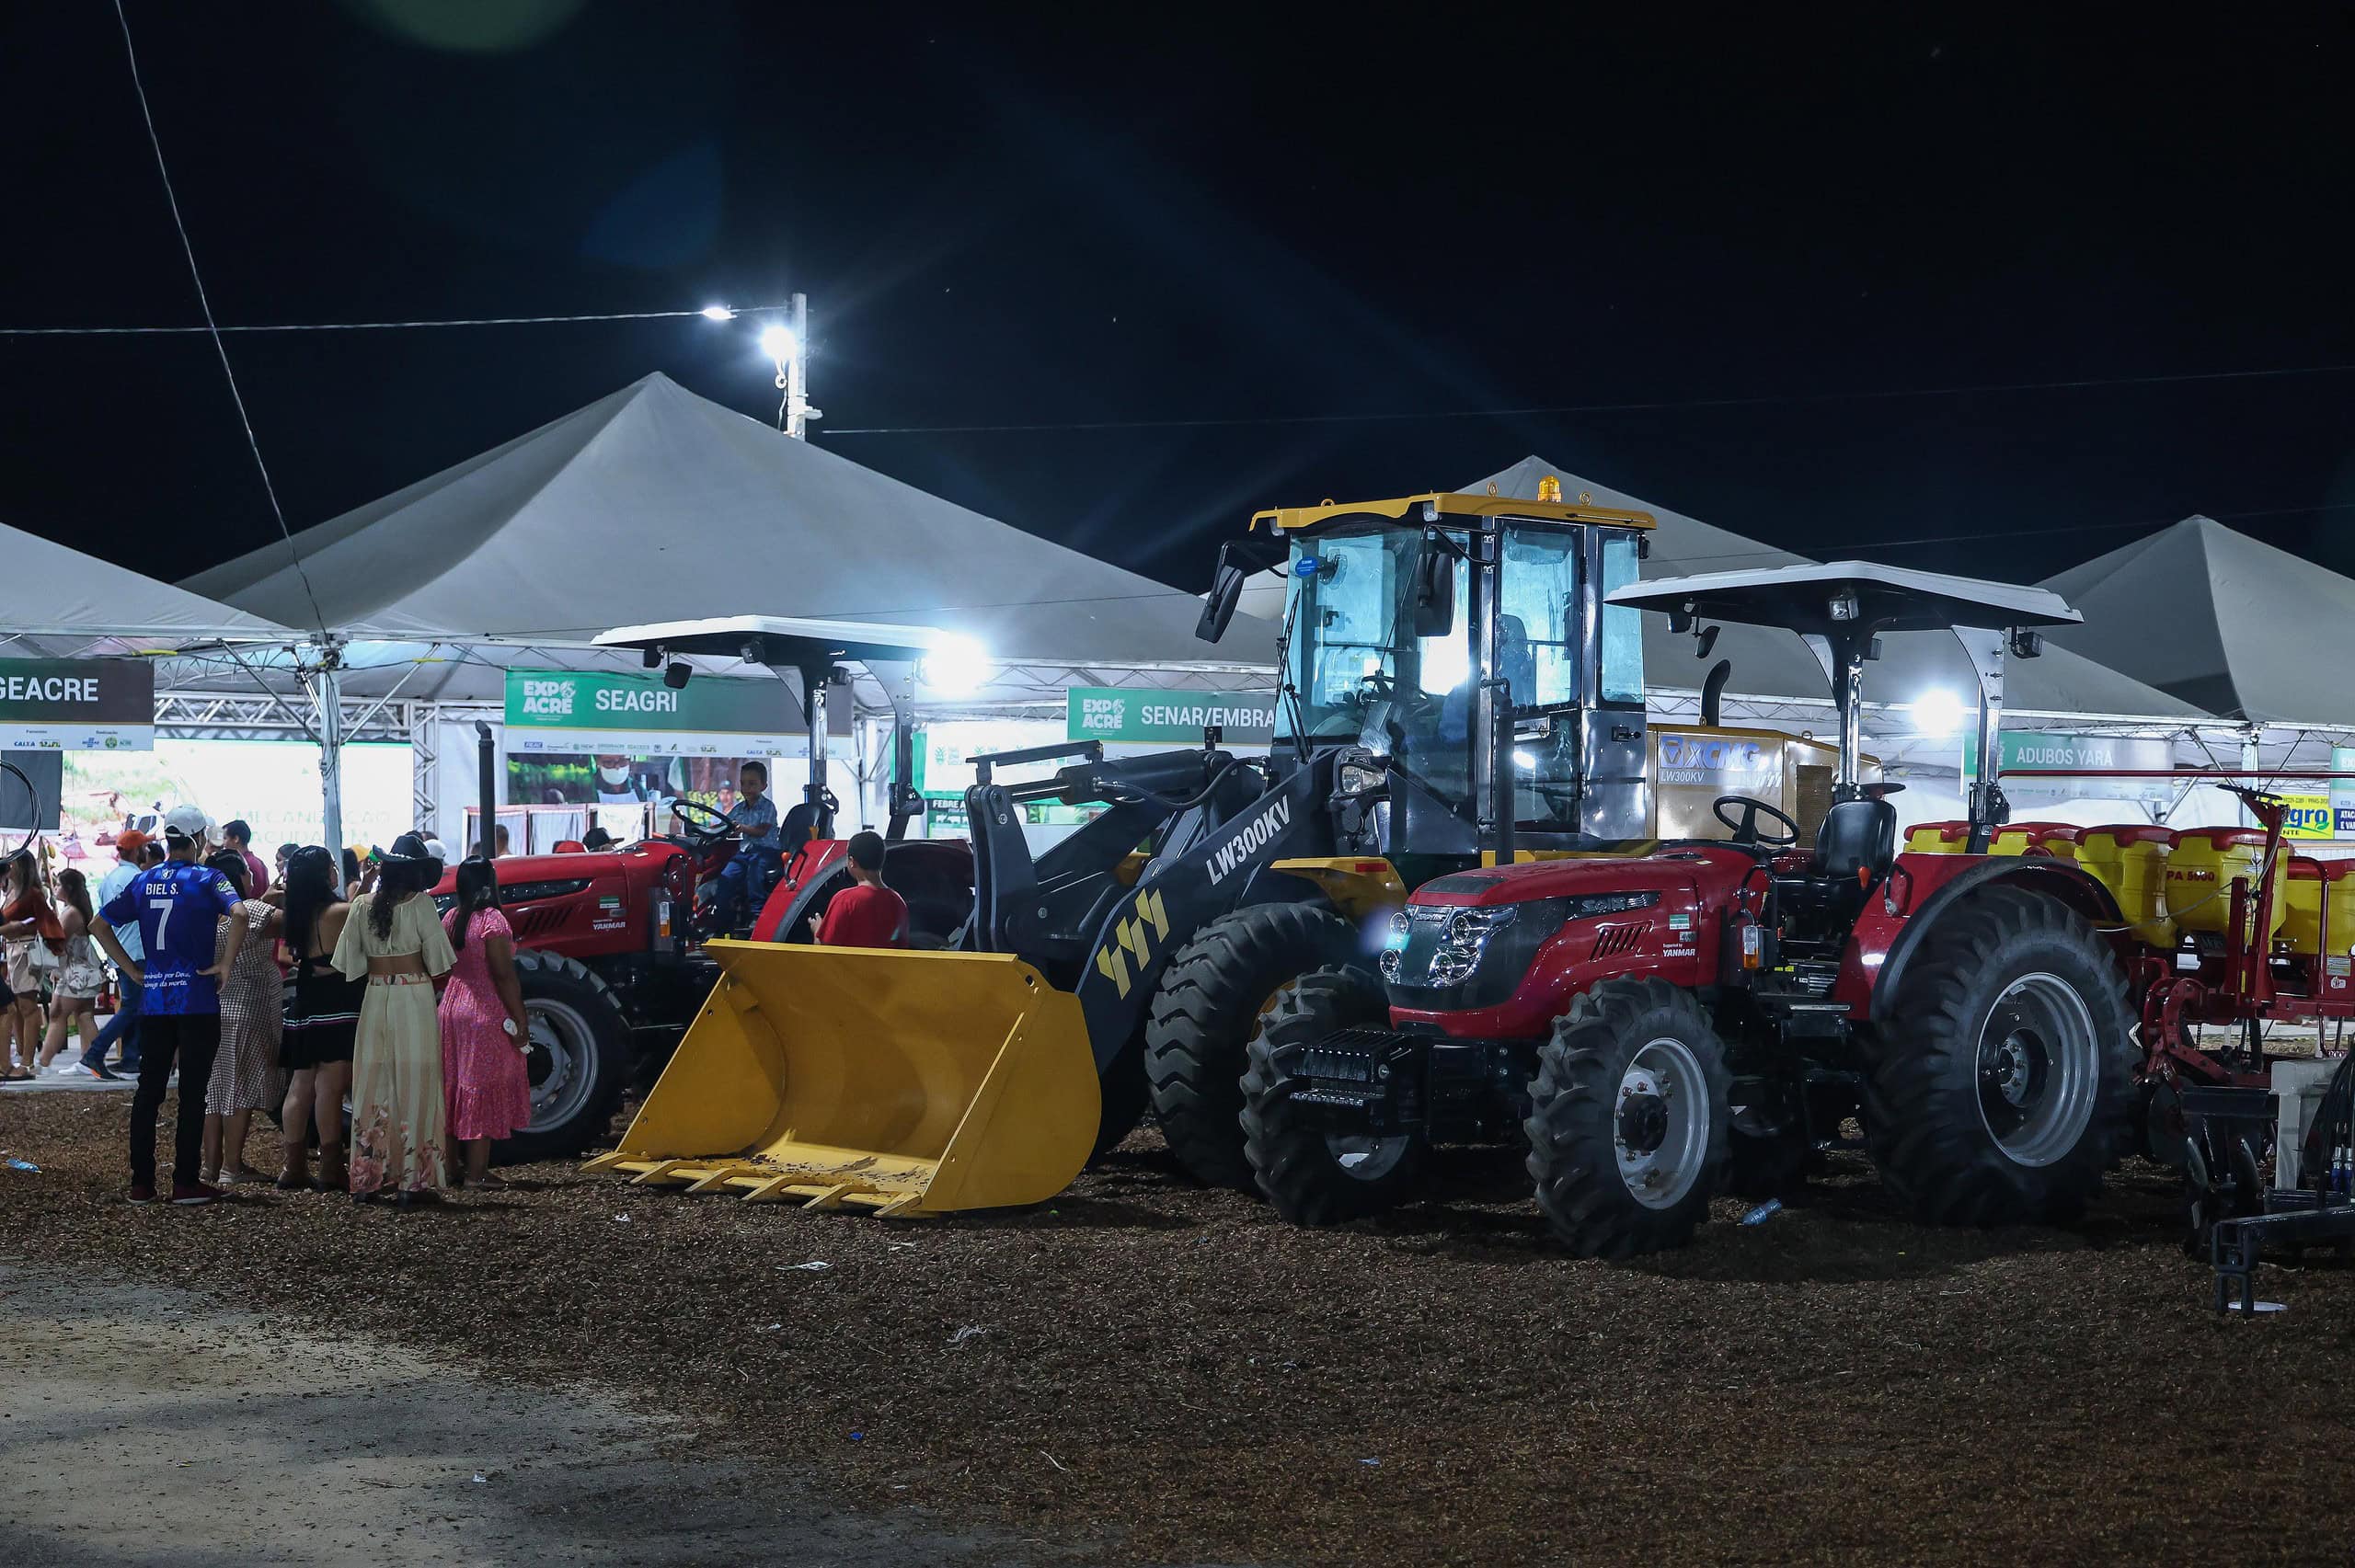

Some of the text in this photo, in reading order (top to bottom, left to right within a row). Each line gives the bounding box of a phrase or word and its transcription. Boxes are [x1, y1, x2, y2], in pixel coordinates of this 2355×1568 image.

[523, 697, 573, 714] ACRE
[595, 689, 677, 712] SEAGRI
[1082, 713, 1123, 729] ACRE
[1684, 741, 1761, 769] XCMG
[2016, 747, 2074, 764] ADUBOS
[2078, 749, 2113, 766] YARA
[1660, 772, 1705, 782] LW300KV
[2286, 808, 2328, 827] gro
[1206, 794, 1290, 886] LW300KV
[2167, 871, 2183, 880] PA
[145, 883, 178, 895] BIEL S.
[149, 898, 174, 950] 7
[592, 921, 626, 931] YANMAR
[1662, 948, 1695, 957] YANMAR
